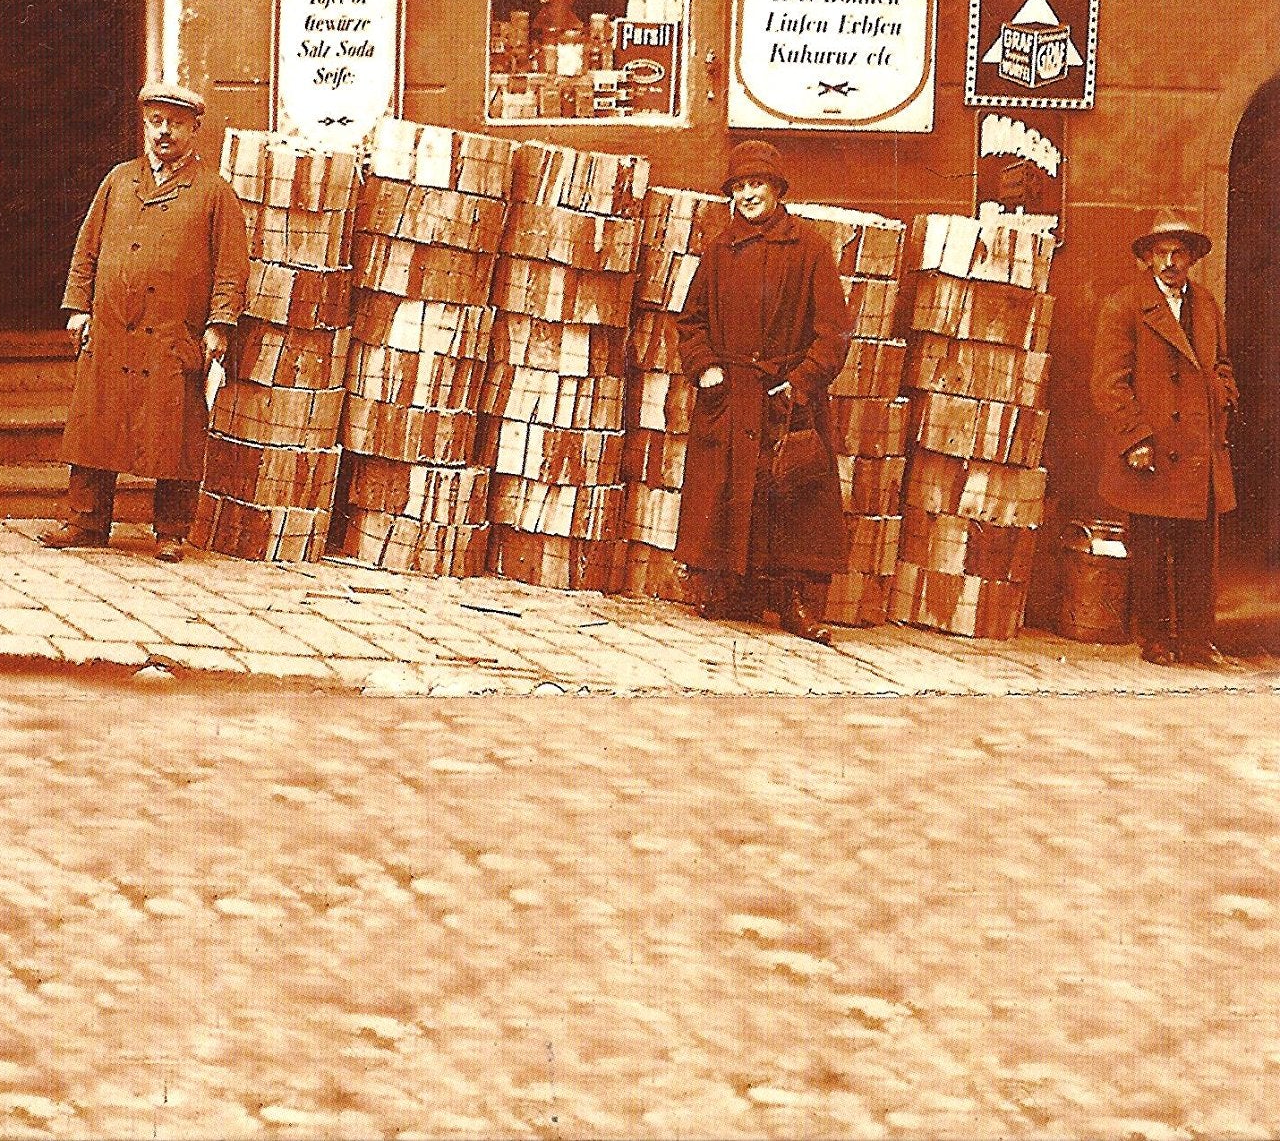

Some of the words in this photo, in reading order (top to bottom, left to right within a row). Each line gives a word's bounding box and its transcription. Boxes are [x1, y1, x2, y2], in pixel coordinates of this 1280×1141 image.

[304, 14, 371, 32] Gewürze
[296, 39, 331, 59] Salz
[336, 39, 375, 58] Soda
[769, 43, 858, 65] Kukuruz
